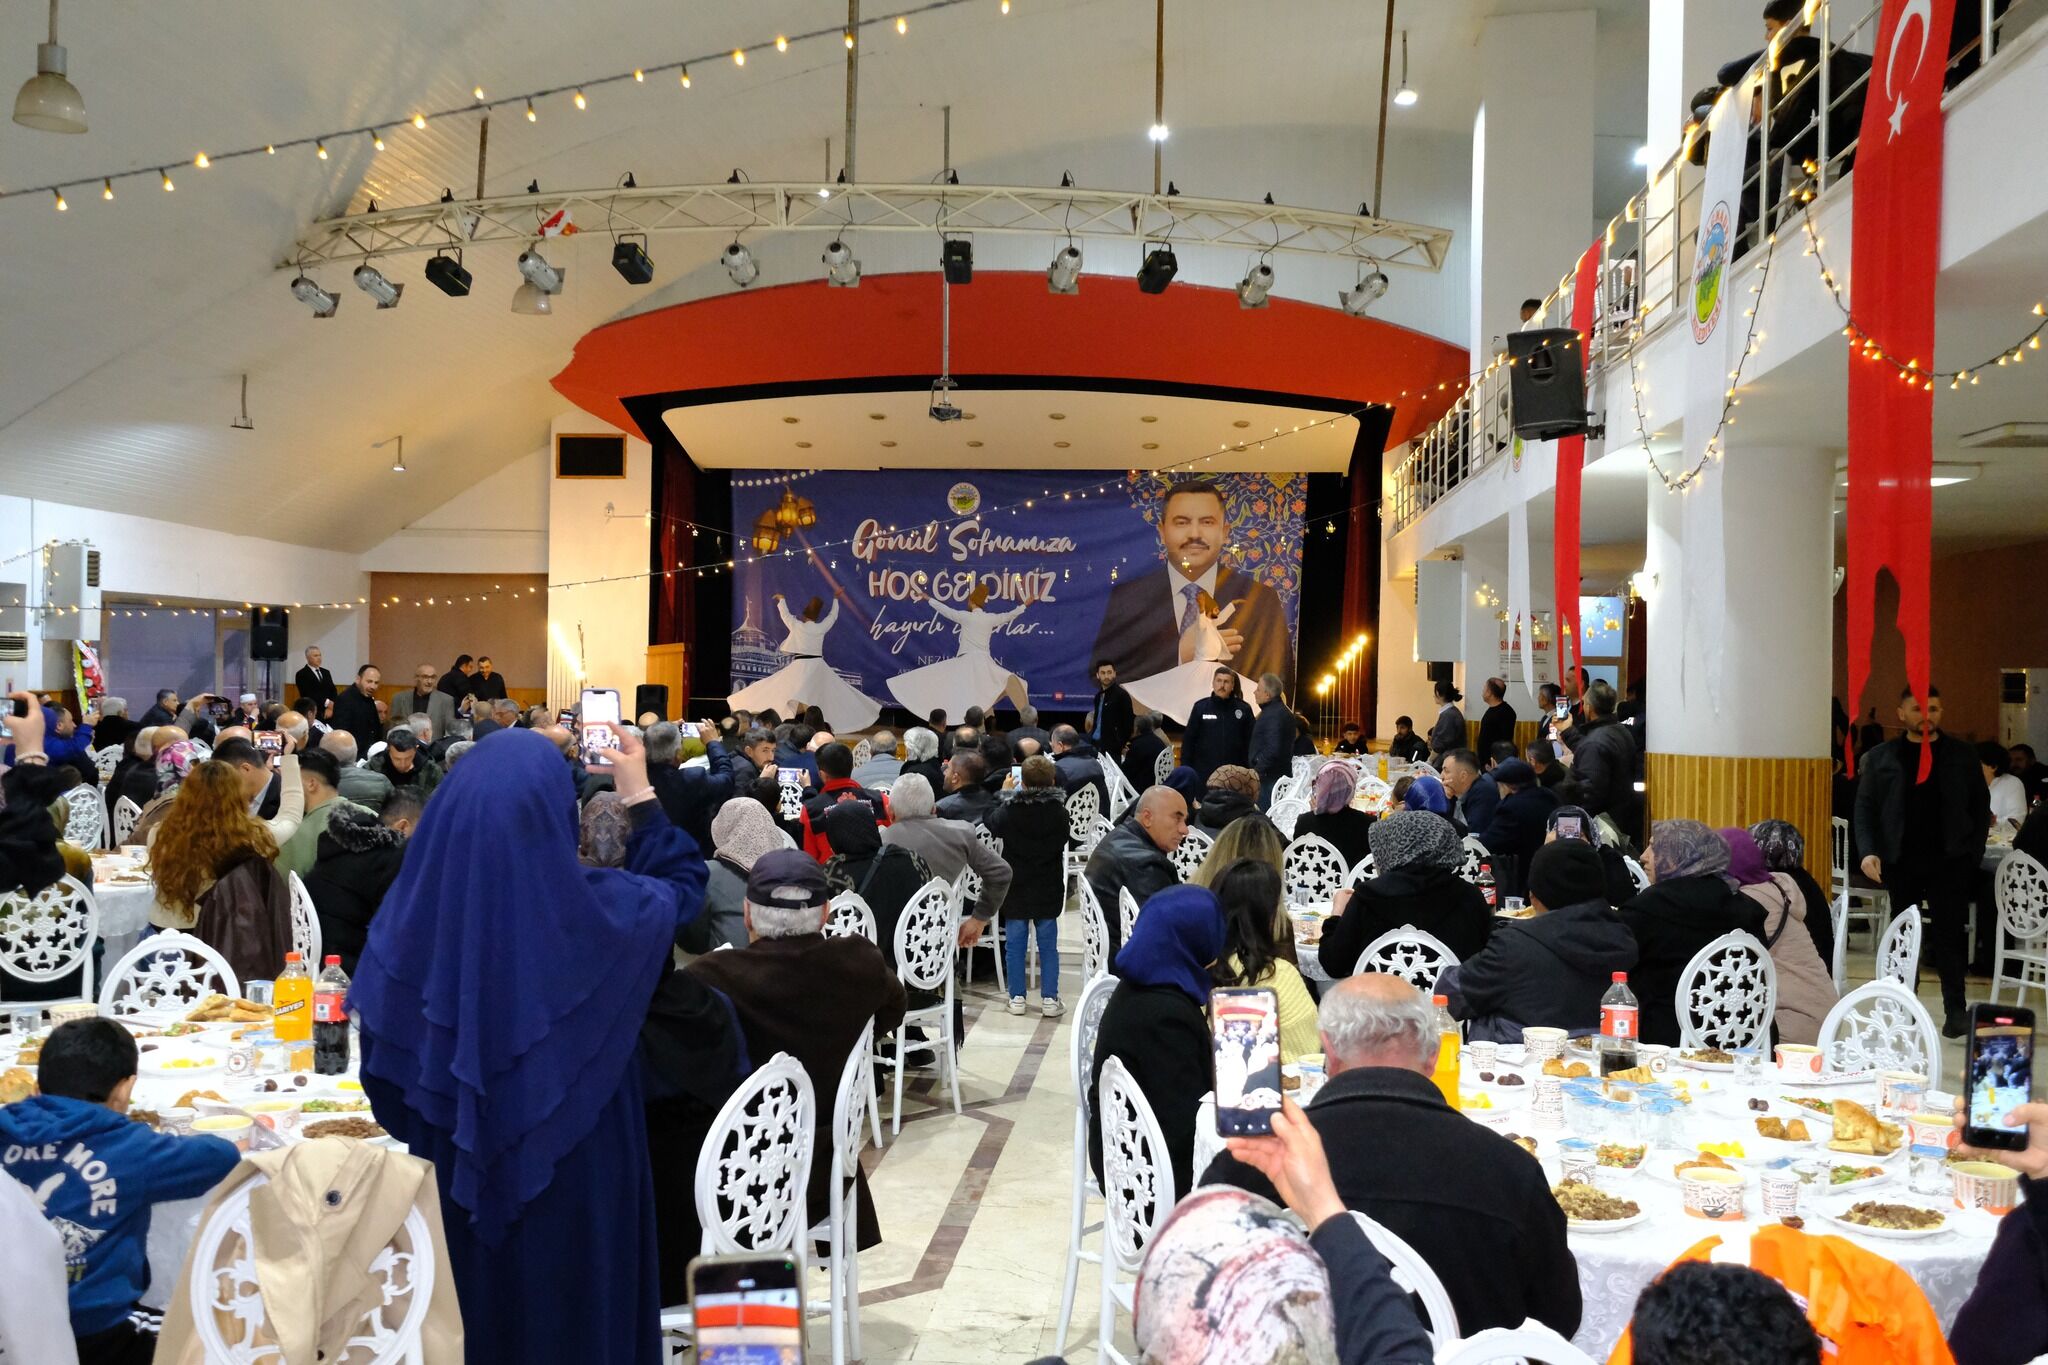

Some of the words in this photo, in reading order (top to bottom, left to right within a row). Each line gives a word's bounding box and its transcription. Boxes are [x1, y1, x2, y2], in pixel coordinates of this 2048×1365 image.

[852, 518, 938, 564] Gönül
[948, 520, 1077, 561] Soframıza
[868, 568, 928, 604] HOŞ
[62, 1142, 118, 1217] MORE
